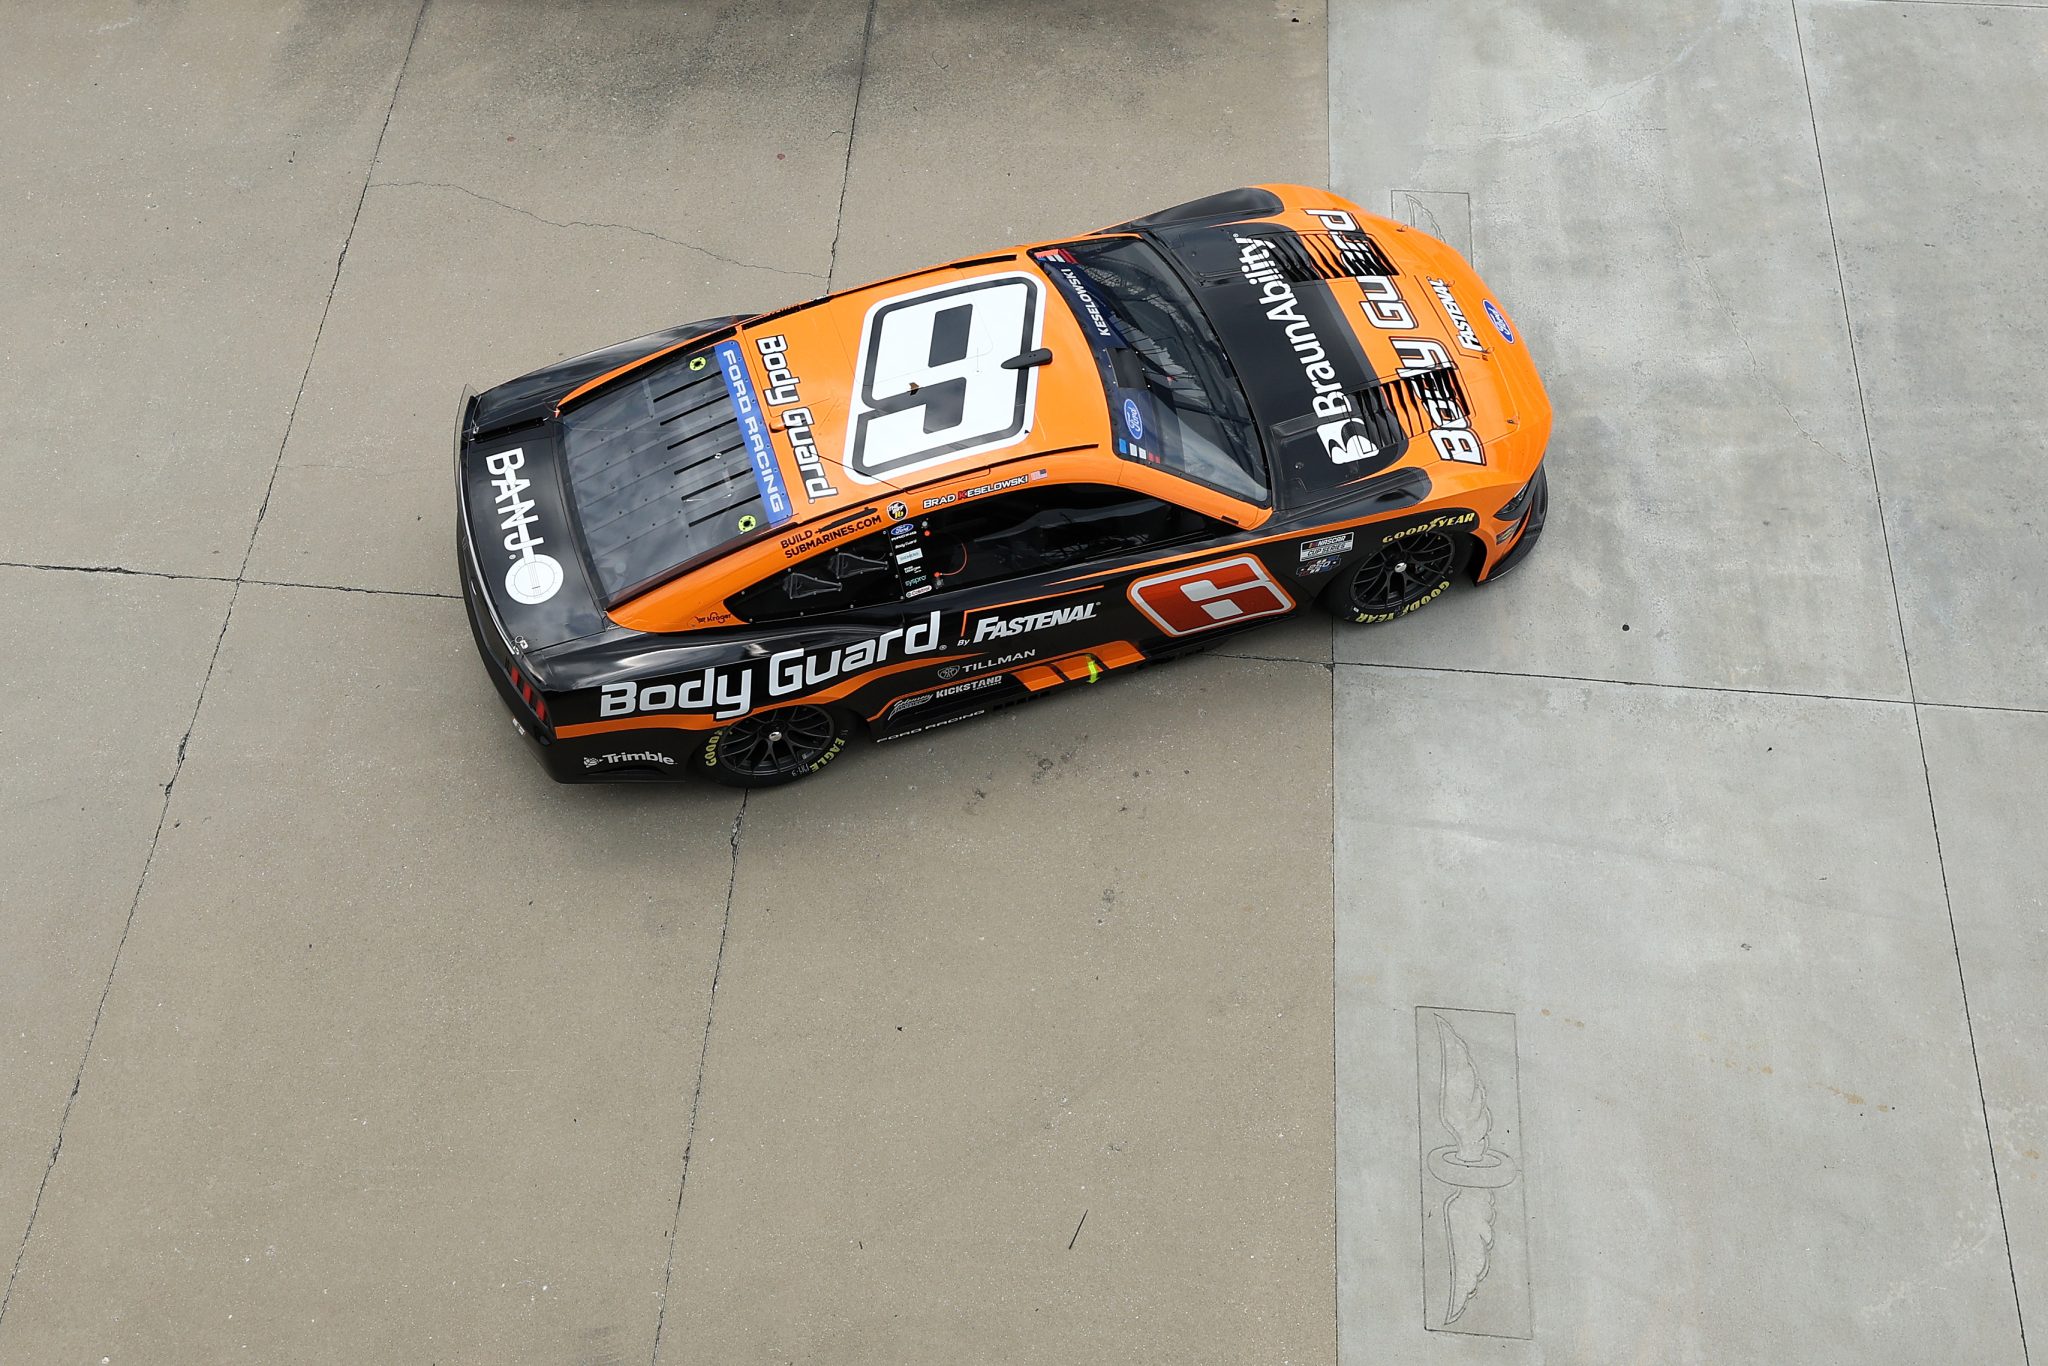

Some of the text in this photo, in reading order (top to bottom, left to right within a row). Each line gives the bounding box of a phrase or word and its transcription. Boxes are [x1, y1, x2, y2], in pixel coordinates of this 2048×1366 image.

[1061, 268, 1111, 336] KESELOWSKI
[1428, 279, 1484, 352] FASTENAL
[1235, 237, 1351, 417] BraunAbility
[1487, 307, 1511, 336] Ford
[723, 349, 784, 513] FORD RACING
[756, 334, 839, 499] Body Guard
[1127, 405, 1141, 433] Ford
[923, 474, 1029, 509] BRAD KESELOWSKI
[780, 529, 813, 549] BUILD
[784, 514, 882, 559] SUBMARINES.COM
[1317, 535, 1346, 547] NASCAR
[1382, 512, 1475, 544] GOODYEAR
[1126, 553, 1296, 638] 6
[707, 611, 731, 624] Kroger
[957, 603, 1097, 647] By FASTENAL
[600, 611, 941, 719] Body Guard
[962, 649, 1036, 673] TILLMAN
[935, 675, 1003, 699] KICKSTAND
[876, 727, 922, 743] FORD
[602, 751, 675, 765] Trimble
[810, 737, 845, 773] EAGLE
